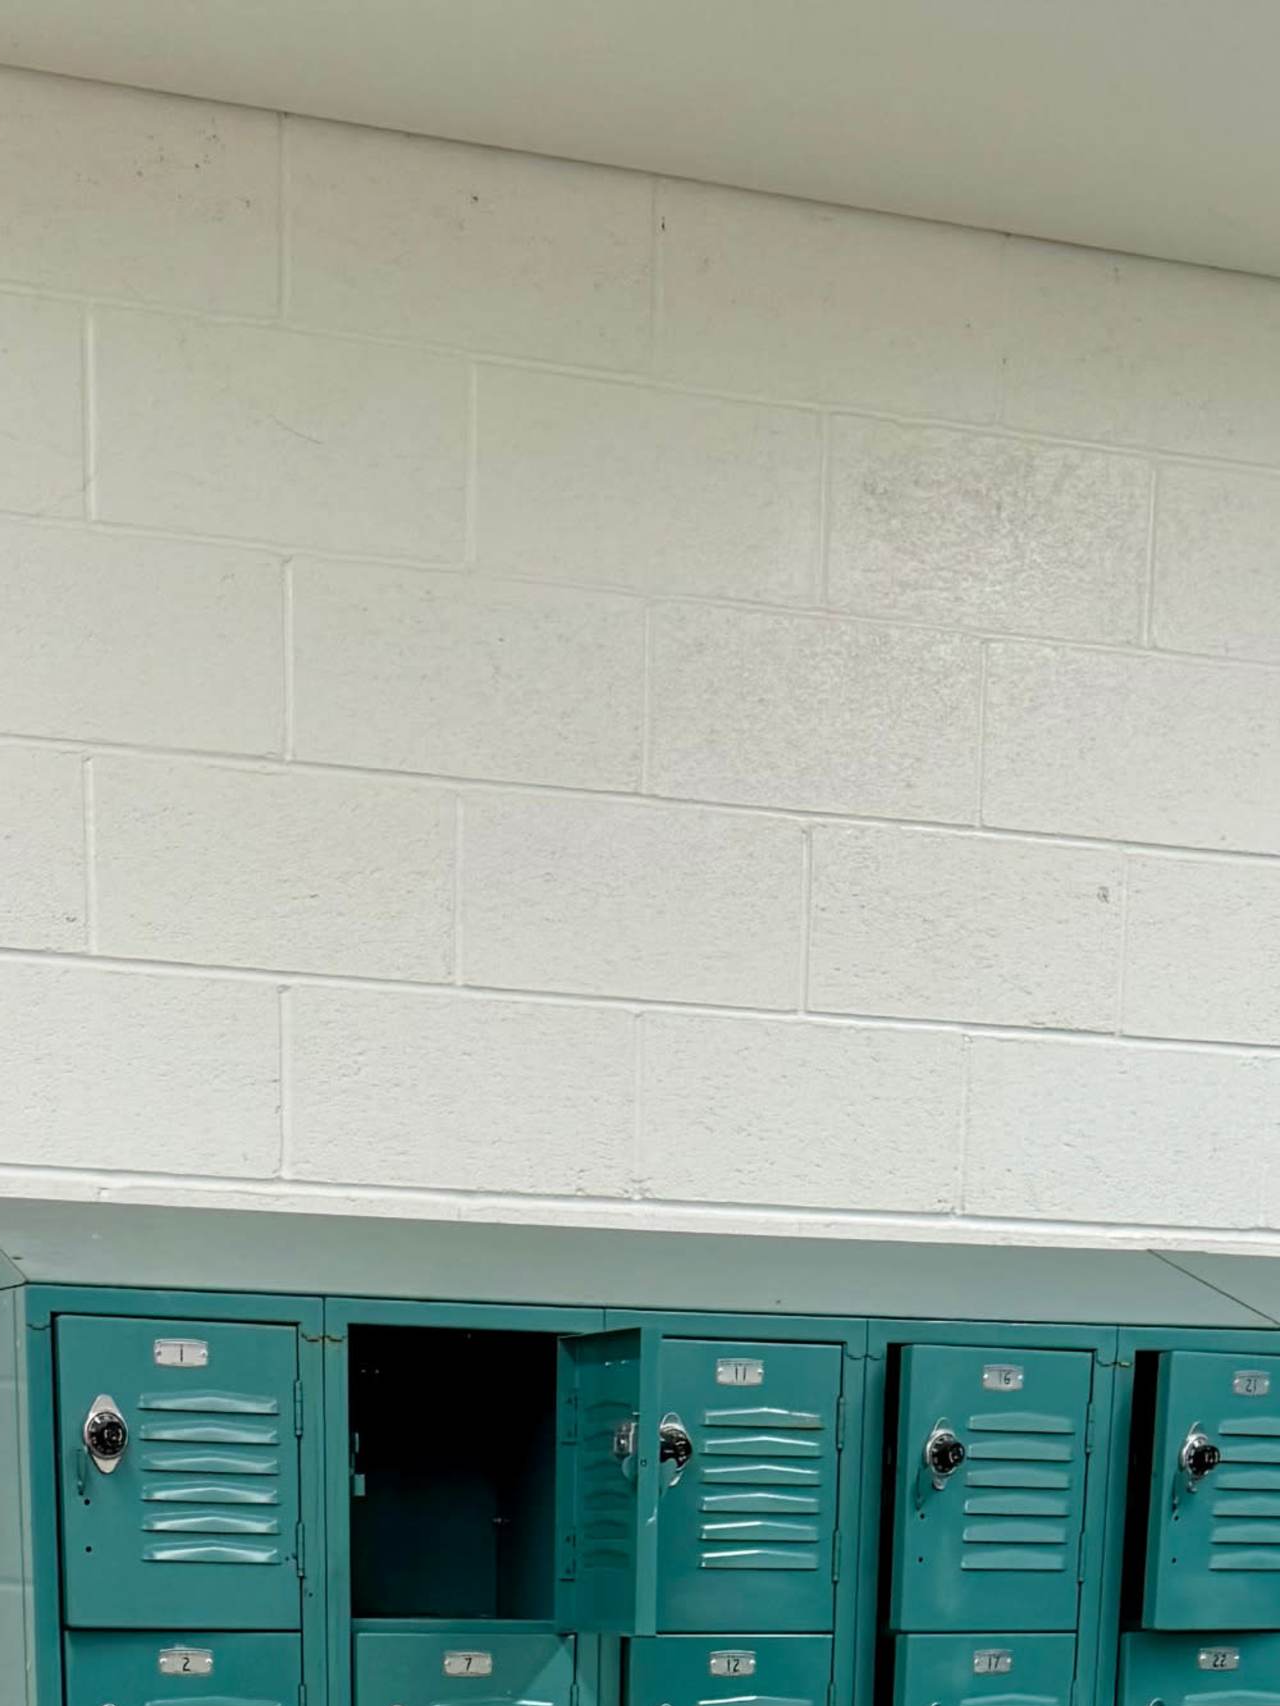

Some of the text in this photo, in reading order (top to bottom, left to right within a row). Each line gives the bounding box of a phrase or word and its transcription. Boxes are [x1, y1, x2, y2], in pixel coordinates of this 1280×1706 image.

[735, 1366, 746, 1381] 11
[1000, 1370, 1011, 1385] 16
[1246, 1378, 1257, 1394] 21
[183, 1657, 191, 1671] 2
[464, 1657, 472, 1670] 7
[727, 1658, 740, 1672] 12
[989, 1656, 1000, 1669] 17
[1213, 1654, 1226, 1668] 22
